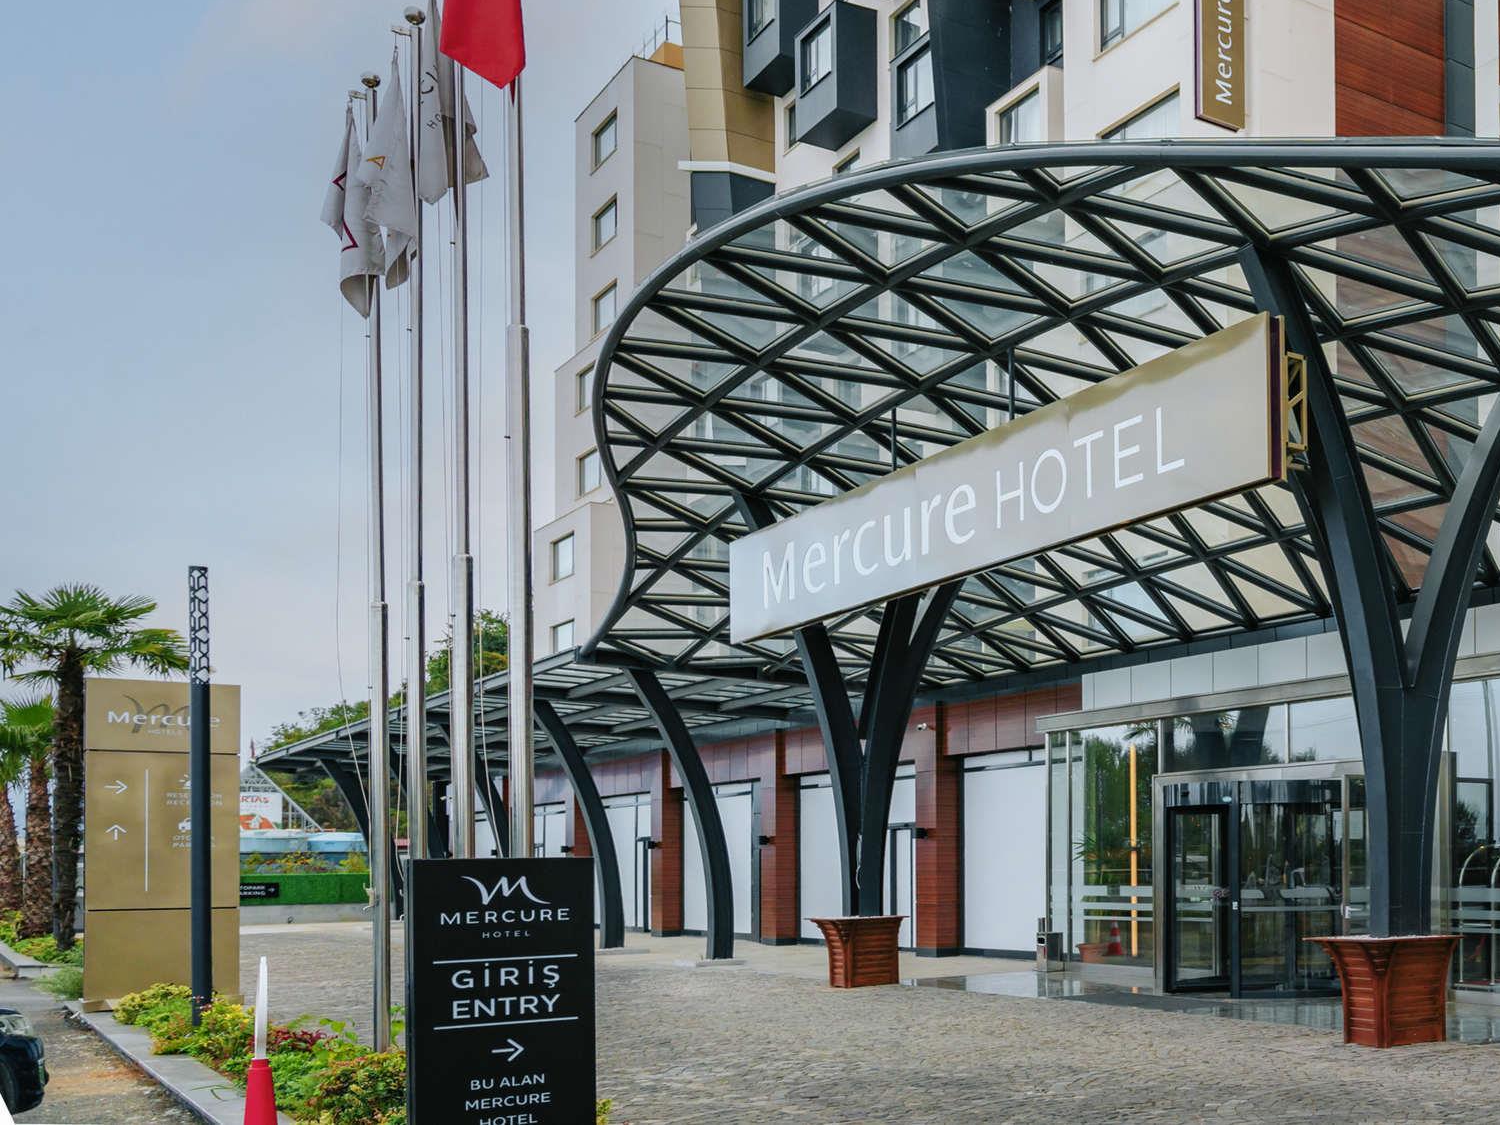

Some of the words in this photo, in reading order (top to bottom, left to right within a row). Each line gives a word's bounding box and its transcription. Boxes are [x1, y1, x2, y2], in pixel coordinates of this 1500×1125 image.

[762, 484, 976, 610] Mercure
[995, 406, 1185, 529] HOTEL
[107, 711, 221, 726] Mercue
[440, 908, 570, 925] MERCURE
[482, 930, 531, 939] HOTEL
[451, 961, 560, 988] GİRİŞ
[452, 993, 561, 1019] ENTRY
[470, 1078, 494, 1091] BU
[500, 1073, 545, 1088] ALAN
[465, 1092, 551, 1111] MERCURE
